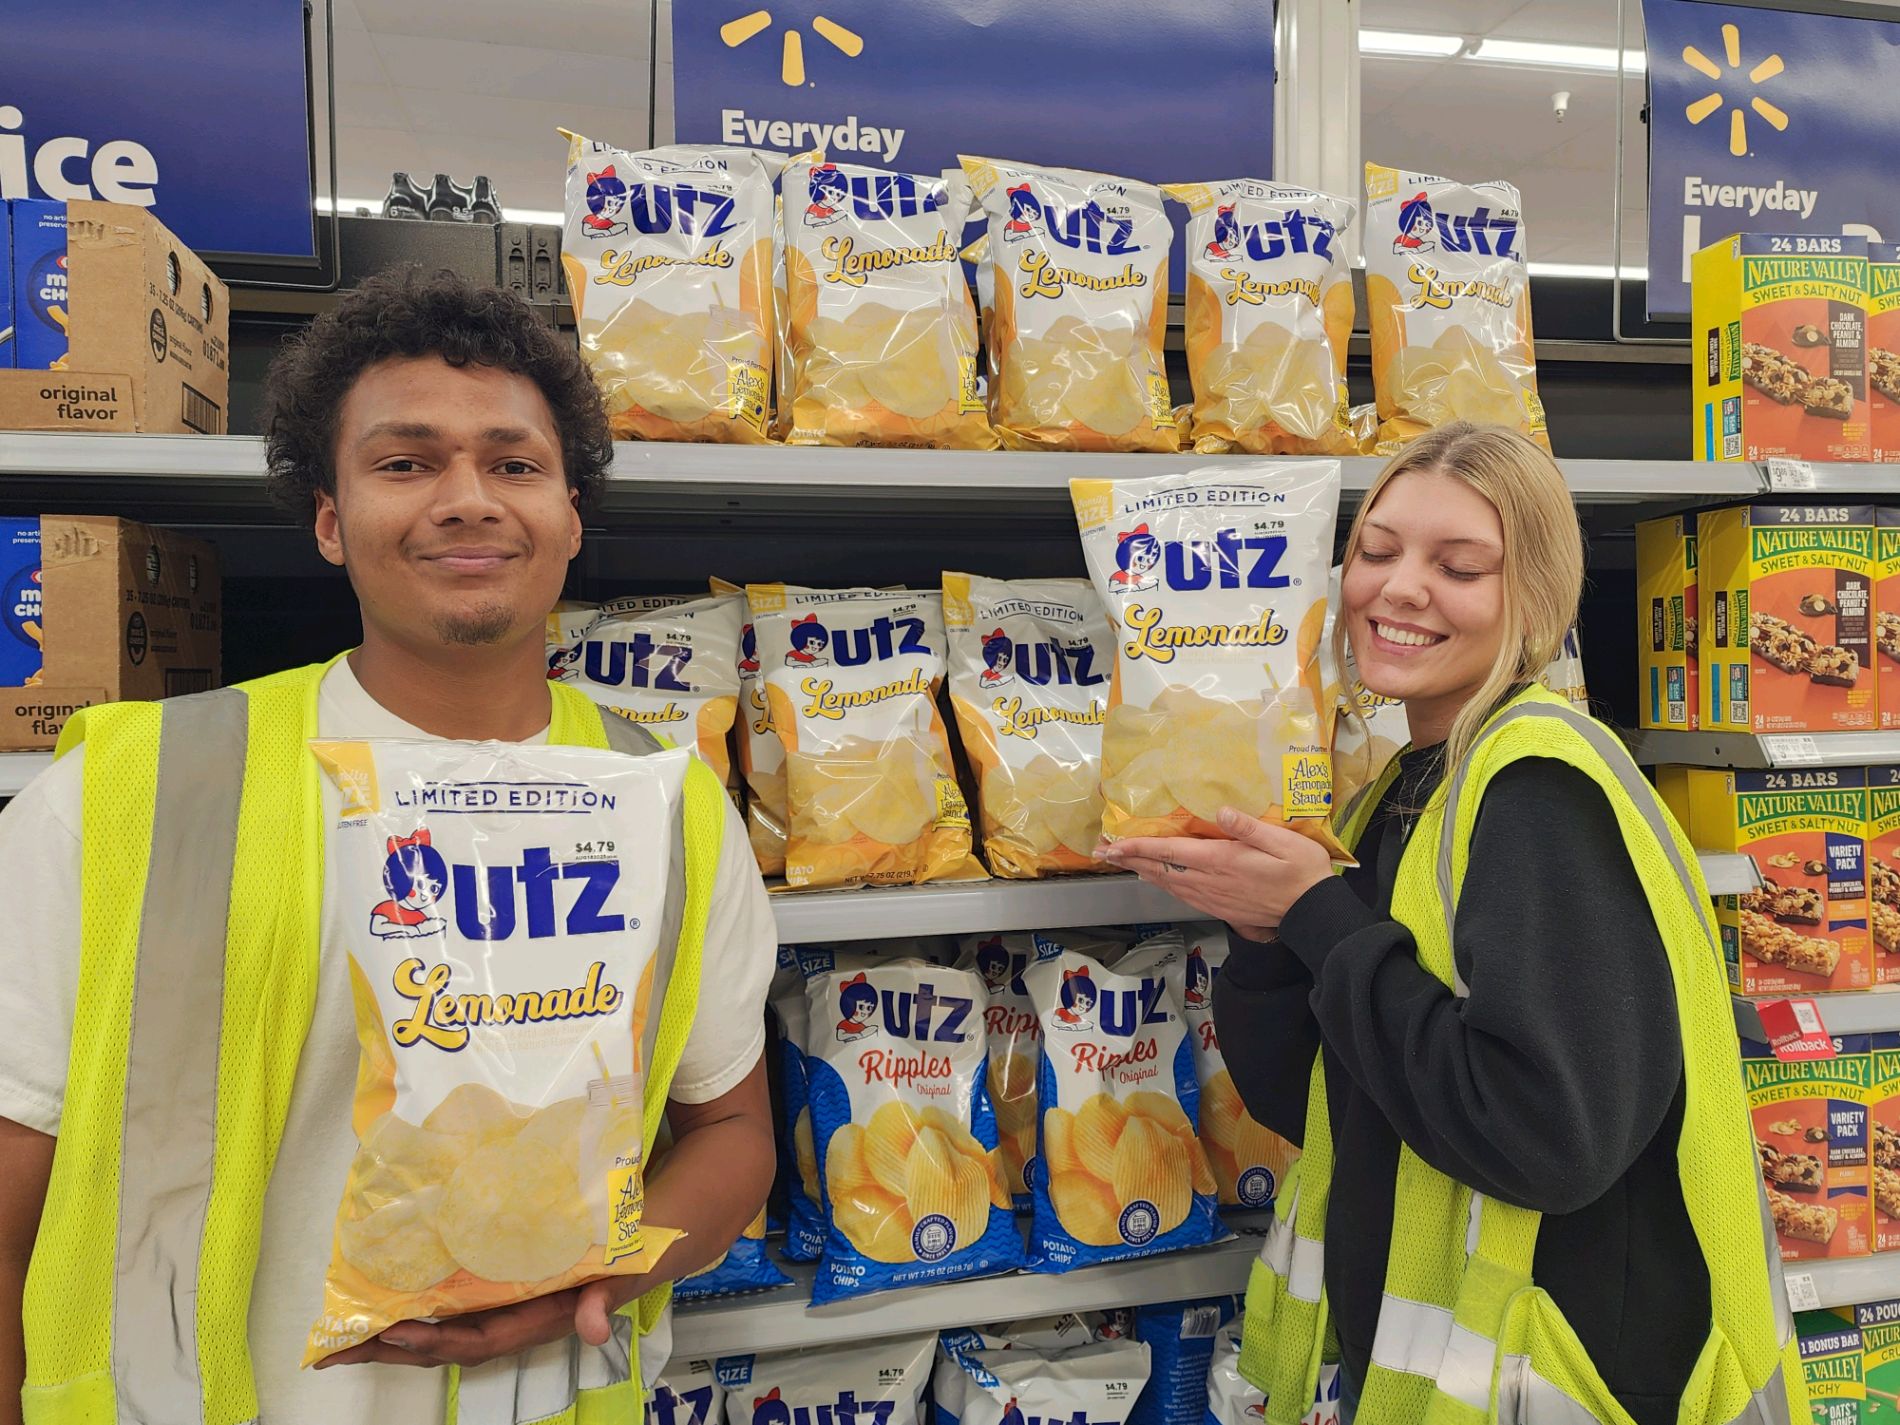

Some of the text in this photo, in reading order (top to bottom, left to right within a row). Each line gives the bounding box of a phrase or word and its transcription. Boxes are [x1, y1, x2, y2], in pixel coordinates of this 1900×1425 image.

[722, 109, 905, 162] Everyday
[1219, 184, 1263, 198] LIMED
[1684, 176, 1818, 219] Everyday
[1771, 238, 1841, 252] 24 BARS
[822, 230, 957, 287] Lemonade
[1020, 249, 1147, 298] Lemonade
[1748, 258, 1865, 290] NATURE VALLEY
[1753, 284, 1862, 305] SWEET & SALTY NUT
[1839, 313, 1854, 321] DARK
[1830, 321, 1863, 331] CHOCOLATE,
[1833, 330, 1861, 339] PEANUT &
[1835, 339, 1859, 348] ALMOND
[40, 386, 118, 403] original
[57, 404, 118, 420] flavor
[1748, 446, 1758, 456] 24
[1874, 449, 1882, 458] 24
[1125, 490, 1286, 514] LIMITED EDITION
[1780, 508, 1849, 522] 24 BARS
[1254, 521, 1285, 530] $4.79
[1756, 530, 1871, 559] NATURE VALLEY
[1761, 554, 1868, 574] SWEET & SALTY NUT
[1846, 582, 1860, 591] DARK
[1836, 591, 1869, 600] CHOCOLATE,
[980, 601, 1084, 622] LIMITED EDITION
[1839, 600, 1867, 608] PEANUT &
[1842, 608, 1865, 617] ALMOND
[666, 633, 692, 641] $4.79
[1124, 603, 1288, 664] Lemonade
[801, 668, 930, 720] Lemonade
[992, 696, 1105, 740] Lemonade
[1755, 715, 1764, 725] 24
[1882, 712, 1891, 722] 24
[1292, 758, 1329, 780] Alex's
[1765, 772, 1838, 788] 24 BARS
[394, 789, 616, 810] LIMITED EDITION
[1292, 791, 1322, 805] Stand
[1742, 792, 1863, 823] NATURE VALLEY
[1747, 818, 1861, 840] SWEET & SALTY NUT
[575, 841, 615, 853] $4.79
[1829, 844, 1862, 857] VARIETY
[1835, 858, 1857, 870] PACK
[1039, 943, 1060, 957] SIZE
[801, 959, 830, 976] SIZE
[1877, 968, 1885, 978] 24
[1746, 978, 1755, 986] 24
[393, 958, 623, 1052] Lemonade
[859, 1049, 952, 1089] Ripples
[1119, 1065, 1159, 1084] Original
[1747, 1060, 1866, 1092] NATURE VALLEY
[1750, 1085, 1864, 1106] SWEET & SALTY NUT
[1830, 1111, 1865, 1124] VARIETY
[1837, 1125, 1858, 1137] PACK
[1878, 1234, 1886, 1243] 24
[1043, 1239, 1077, 1255] POTATO
[1049, 1250, 1073, 1264] CHIPS
[830, 1263, 866, 1276] POTATO
[893, 1273, 906, 1282] NET
[908, 1271, 919, 1280] WT
[920, 1269, 936, 1278] 7.75
[936, 1267, 946, 1275] OZ
[833, 1276, 860, 1287] CHIPS
[1860, 1308, 1874, 1323] 24
[1800, 1334, 1860, 1354] 1 BONUS BAR
[718, 1368, 748, 1384] SIZE
[879, 1368, 903, 1377] $4.79
[1812, 1356, 1859, 1381] VALLEY
[1829, 1403, 1851, 1419] OATS
